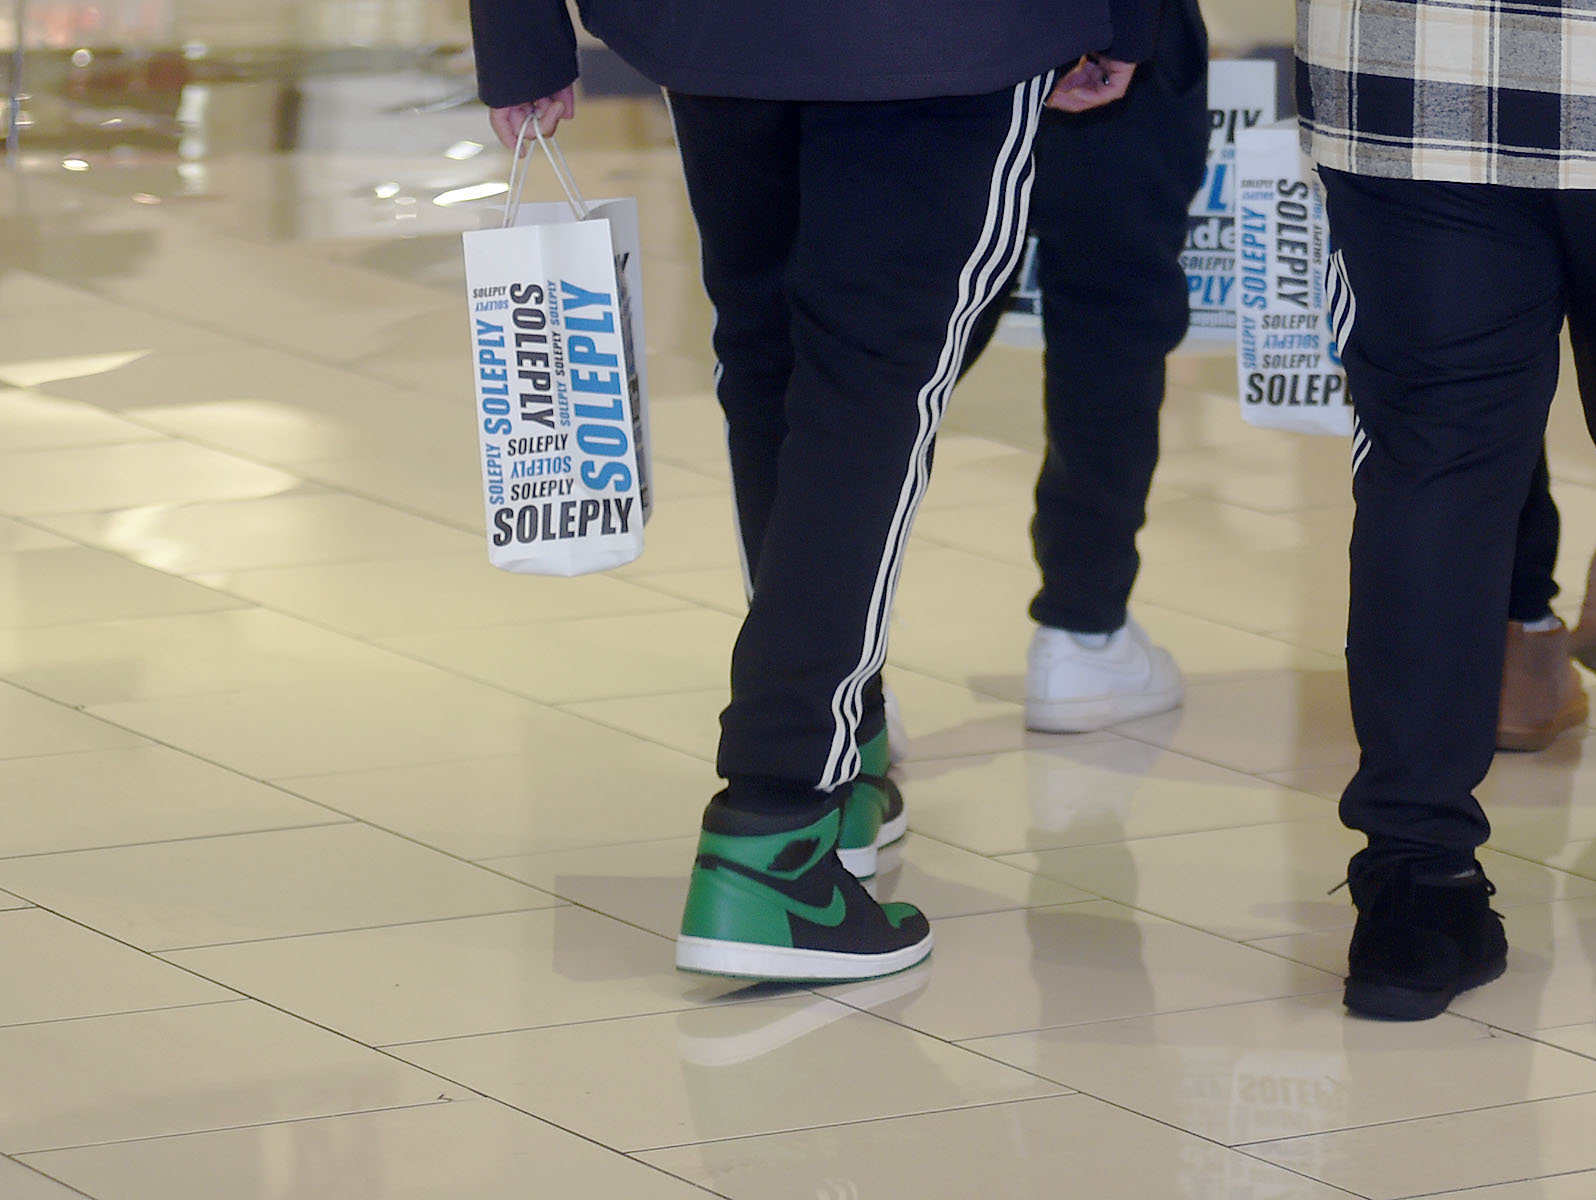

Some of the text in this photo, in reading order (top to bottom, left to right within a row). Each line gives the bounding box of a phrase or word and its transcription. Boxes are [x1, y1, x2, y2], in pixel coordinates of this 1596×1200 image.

[1241, 206, 1267, 310] SOLEPLY
[1276, 179, 1309, 309] SOLEPLY
[473, 286, 507, 298] SOLEPLY
[547, 280, 560, 325] SOLEPLY
[1242, 316, 1257, 370] SOLEPLY
[1261, 314, 1319, 330] SOLEPLY
[510, 283, 556, 429] SOLEPLY
[553, 331, 566, 376] SOLEPLY
[1262, 353, 1322, 369] SOLEPLY
[476, 319, 512, 435] SOLEPLY
[560, 280, 632, 492] SOLEPLY
[558, 382, 571, 426] SOLEPLY
[507, 433, 568, 456] SOLEPLY
[486, 443, 505, 505] SOLEPLY
[510, 456, 571, 479] SOLEPLY
[511, 478, 574, 501] SOLEPLY
[492, 497, 633, 547] SOLEPLY
